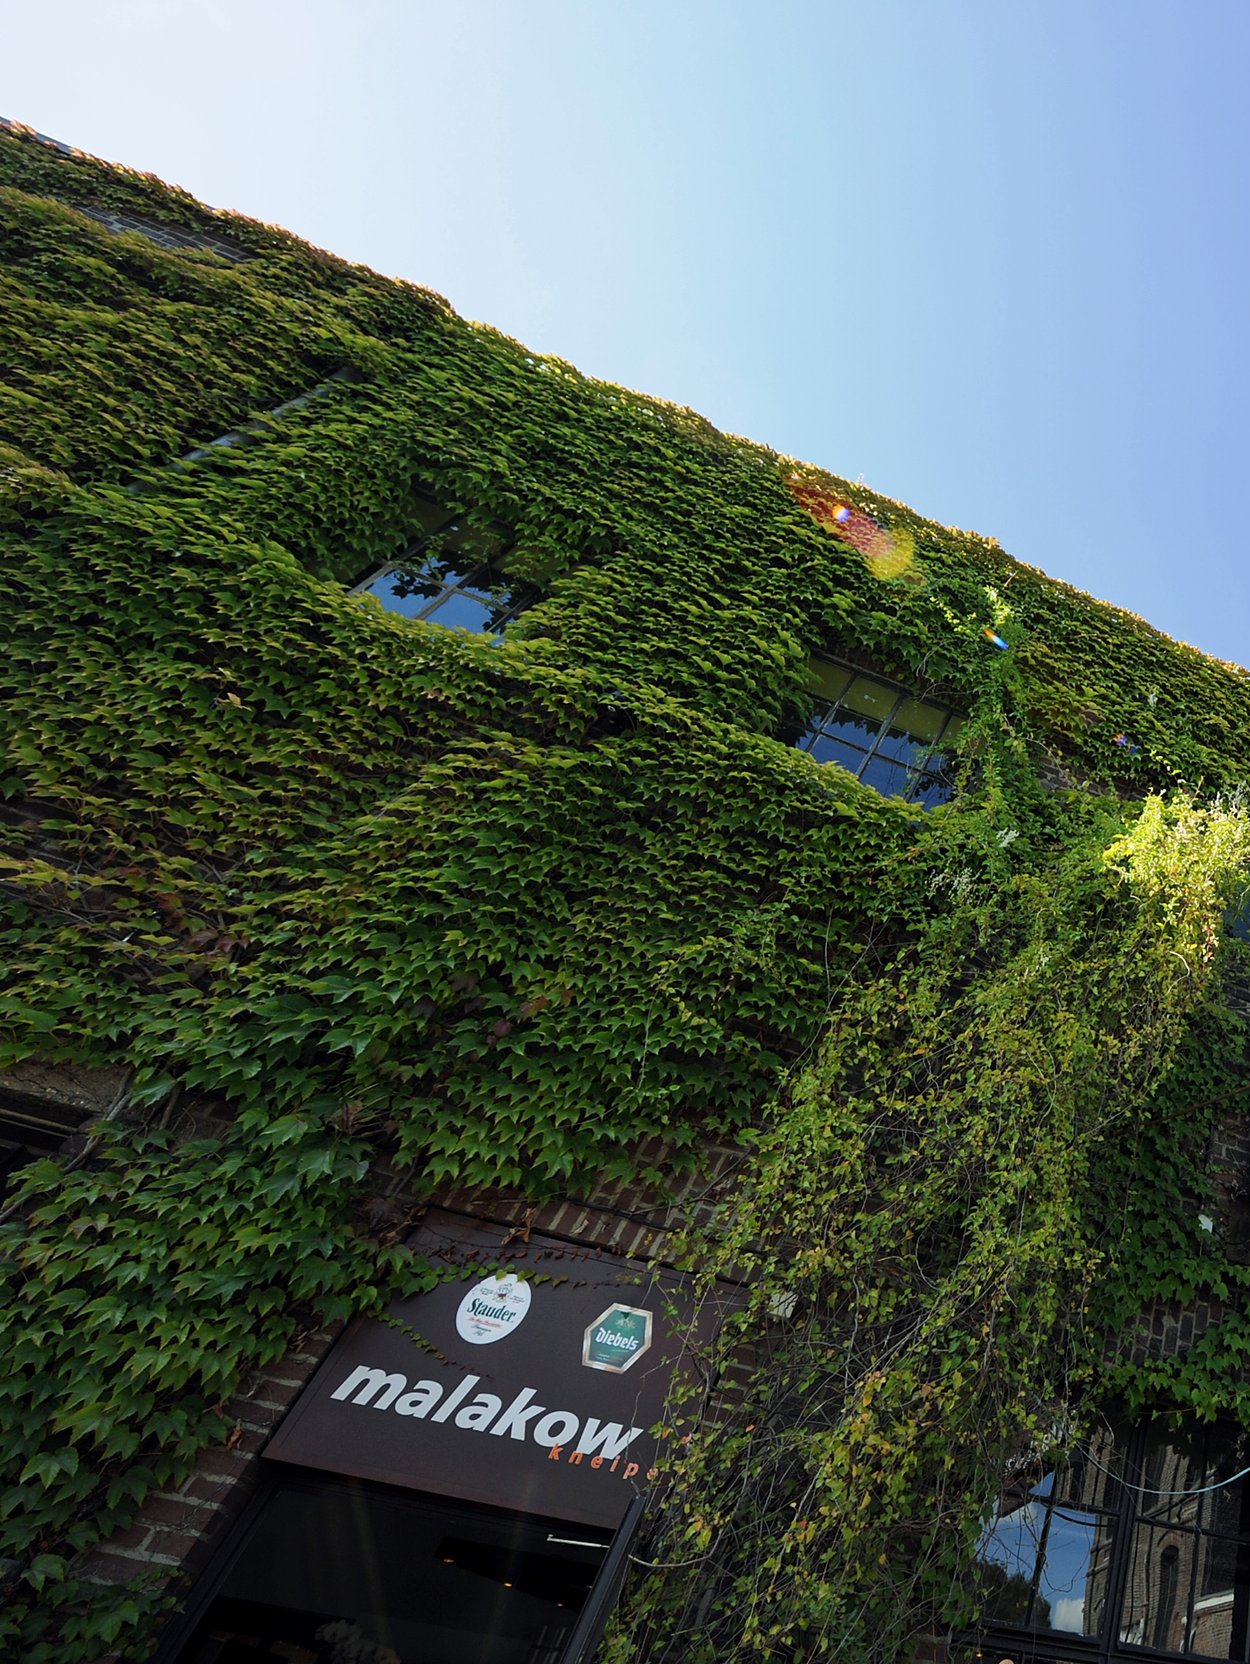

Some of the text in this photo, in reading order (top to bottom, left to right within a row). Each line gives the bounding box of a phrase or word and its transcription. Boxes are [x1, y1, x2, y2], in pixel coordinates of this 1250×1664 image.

[467, 1297, 516, 1323] Stauder
[595, 1327, 639, 1350] Diebels
[330, 1365, 644, 1460] malakow
